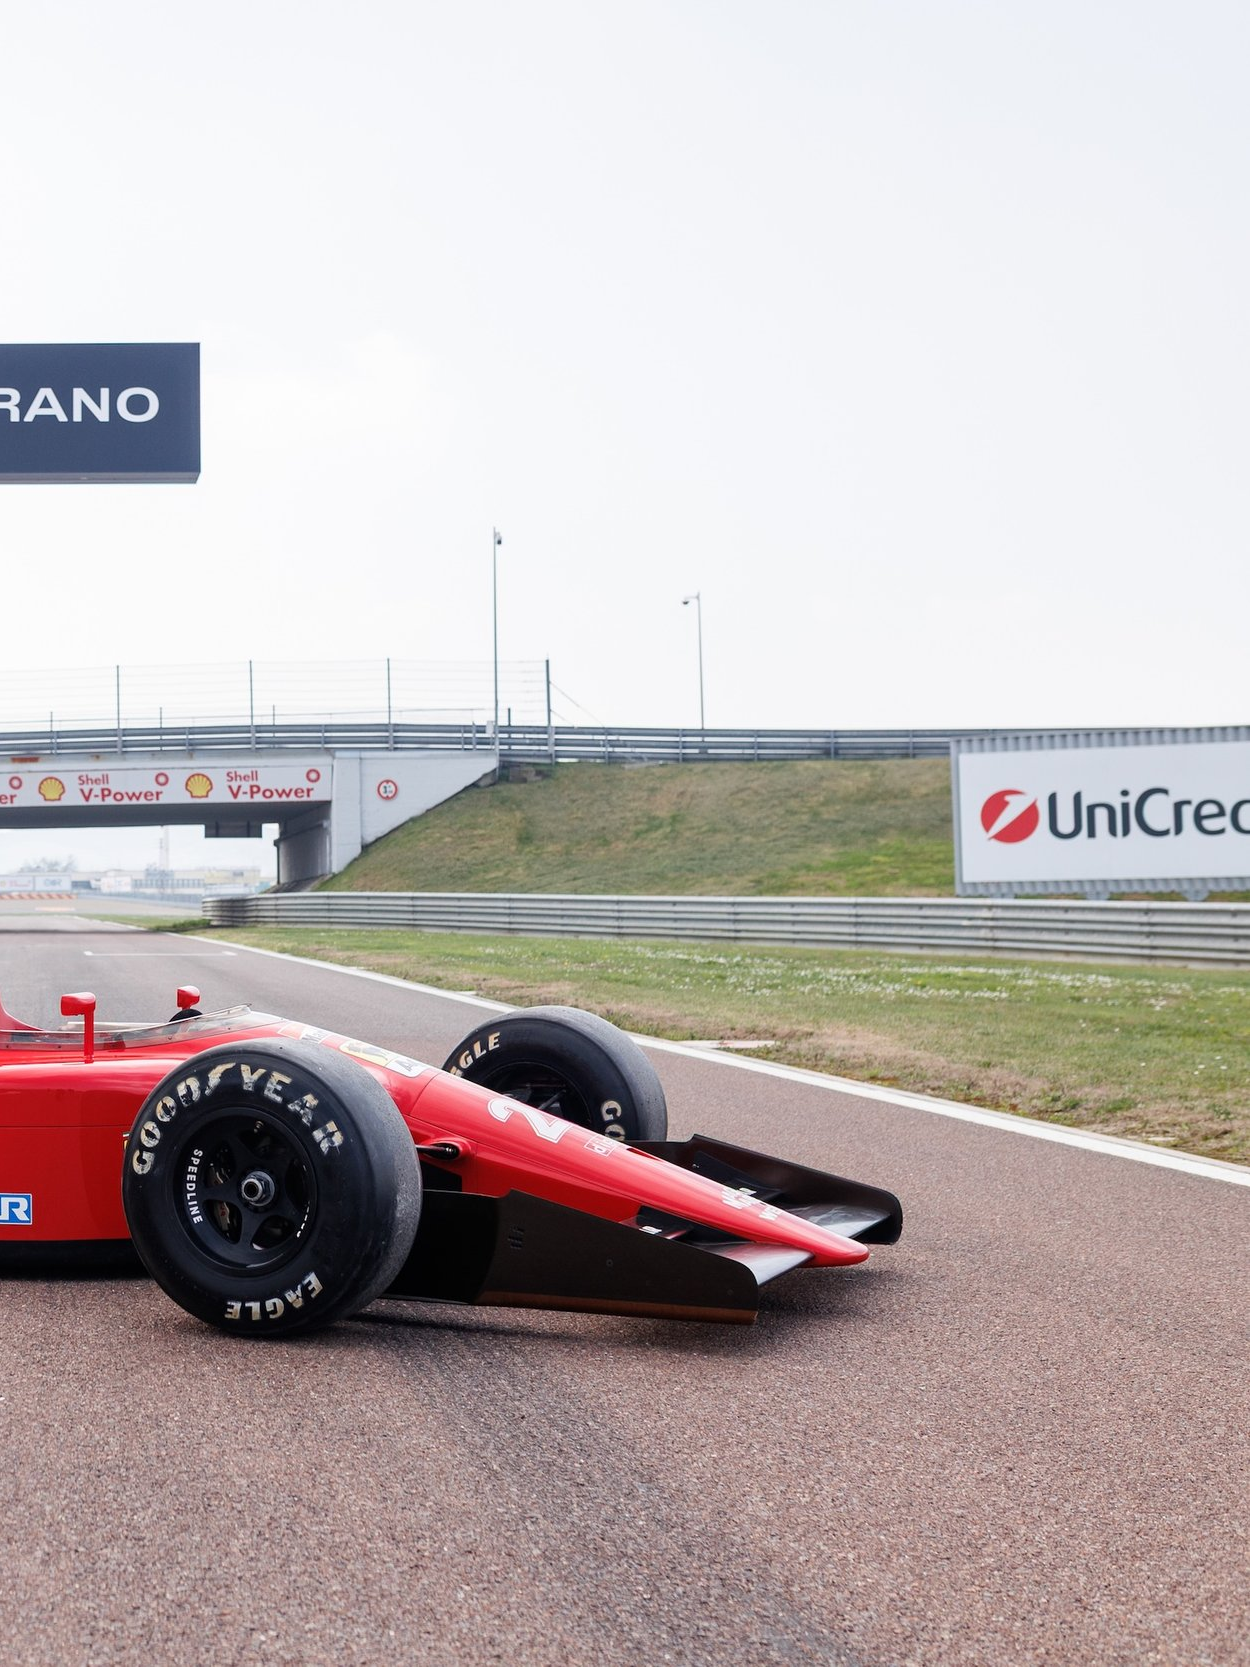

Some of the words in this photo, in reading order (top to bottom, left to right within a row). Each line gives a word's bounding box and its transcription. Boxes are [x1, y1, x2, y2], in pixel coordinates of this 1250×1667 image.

[78, 774, 109, 786] Shell
[226, 770, 258, 783] Shell
[80, 788, 164, 802] V-Power
[228, 785, 315, 800] V-Power
[450, 1032, 501, 1078] GLE
[132, 1062, 344, 1175] GOODYEAR
[185, 1148, 203, 1225] SPEEDLINE
[224, 1271, 324, 1321] EAGLE
